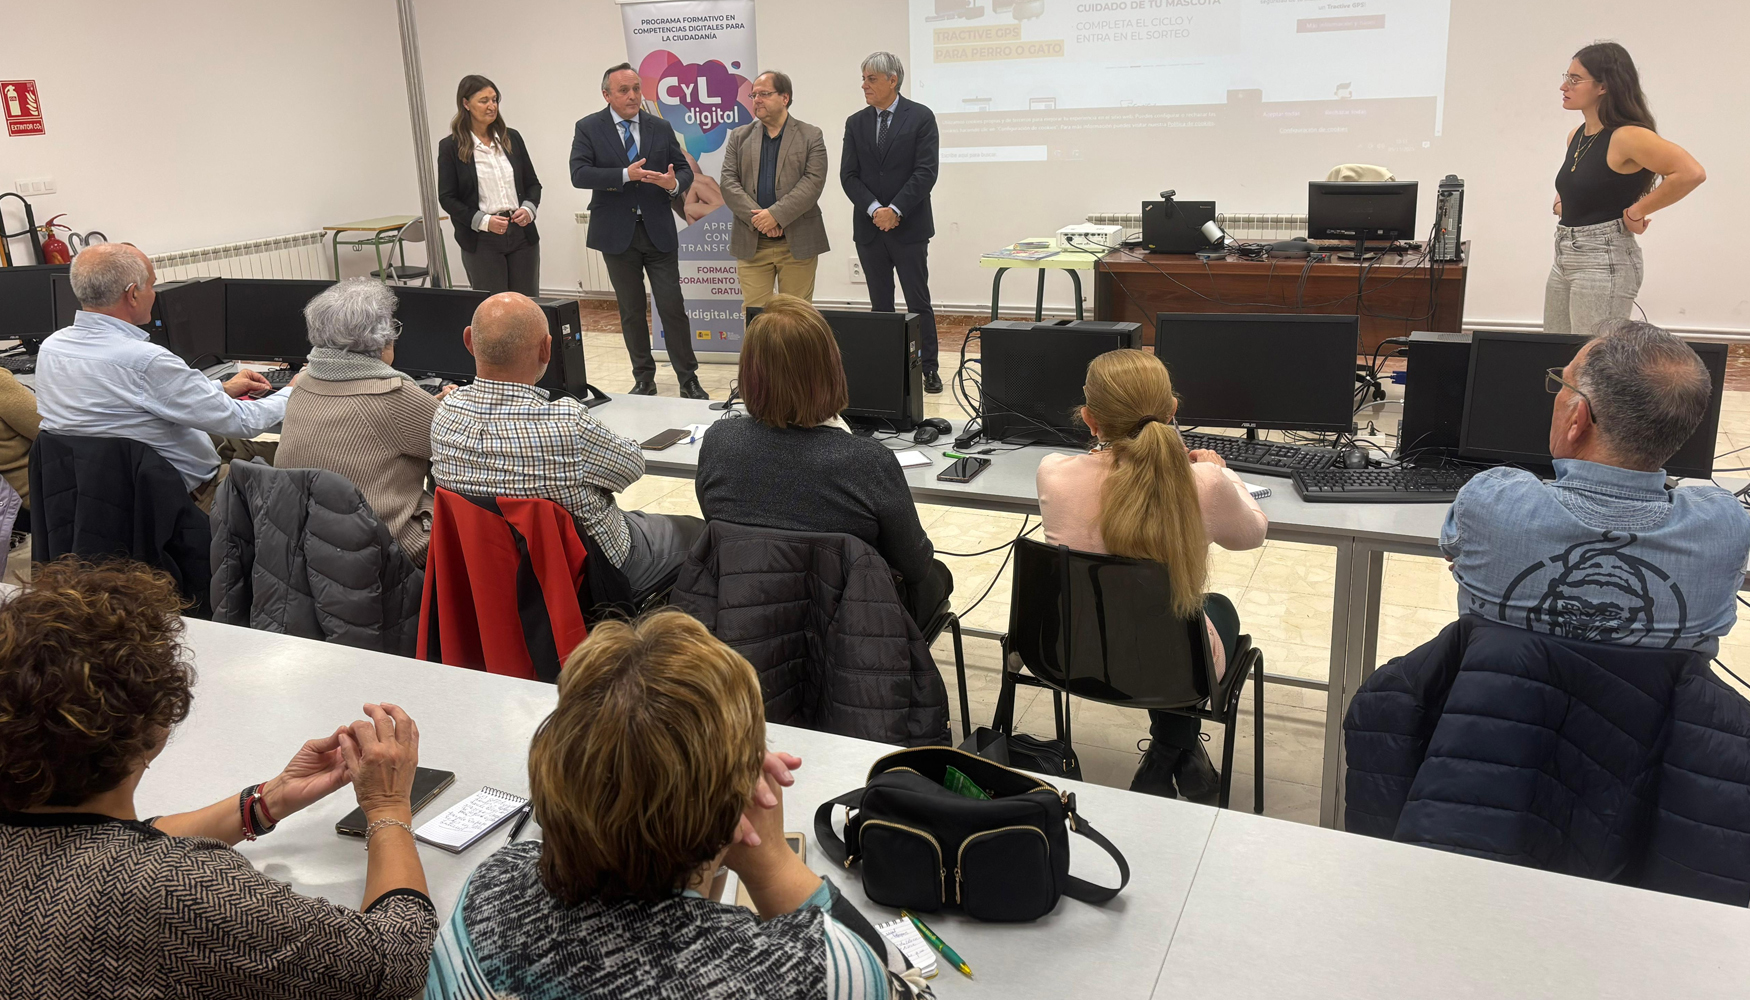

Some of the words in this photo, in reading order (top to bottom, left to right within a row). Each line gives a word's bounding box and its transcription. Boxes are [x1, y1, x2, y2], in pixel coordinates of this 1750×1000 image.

[1076, 2, 1127, 12] CUIDADO
[1130, 1, 1145, 9] DE
[682, 15, 724, 24] FORMATIVO
[1076, 20, 1133, 30] COMPLETA
[1136, 19, 1149, 27] EL
[1151, 17, 1183, 26] CICLO
[1186, 16, 1193, 24] Y
[633, 26, 687, 34] COMPETENCIAS
[936, 29, 992, 41] TRACTIVE
[996, 28, 1019, 38] GPS
[1076, 34, 1110, 43] ENTRA
[1114, 33, 1127, 41] EN
[1131, 32, 1143, 40] EL
[1146, 29, 1190, 40] SORTEO
[672, 33, 717, 41] CIUDADANÍA
[936, 49, 968, 59] PARA
[971, 46, 1012, 57] PERRO
[1015, 46, 1024, 55] O
[1028, 43, 1062, 54] GATO
[684, 105, 739, 129] digital
